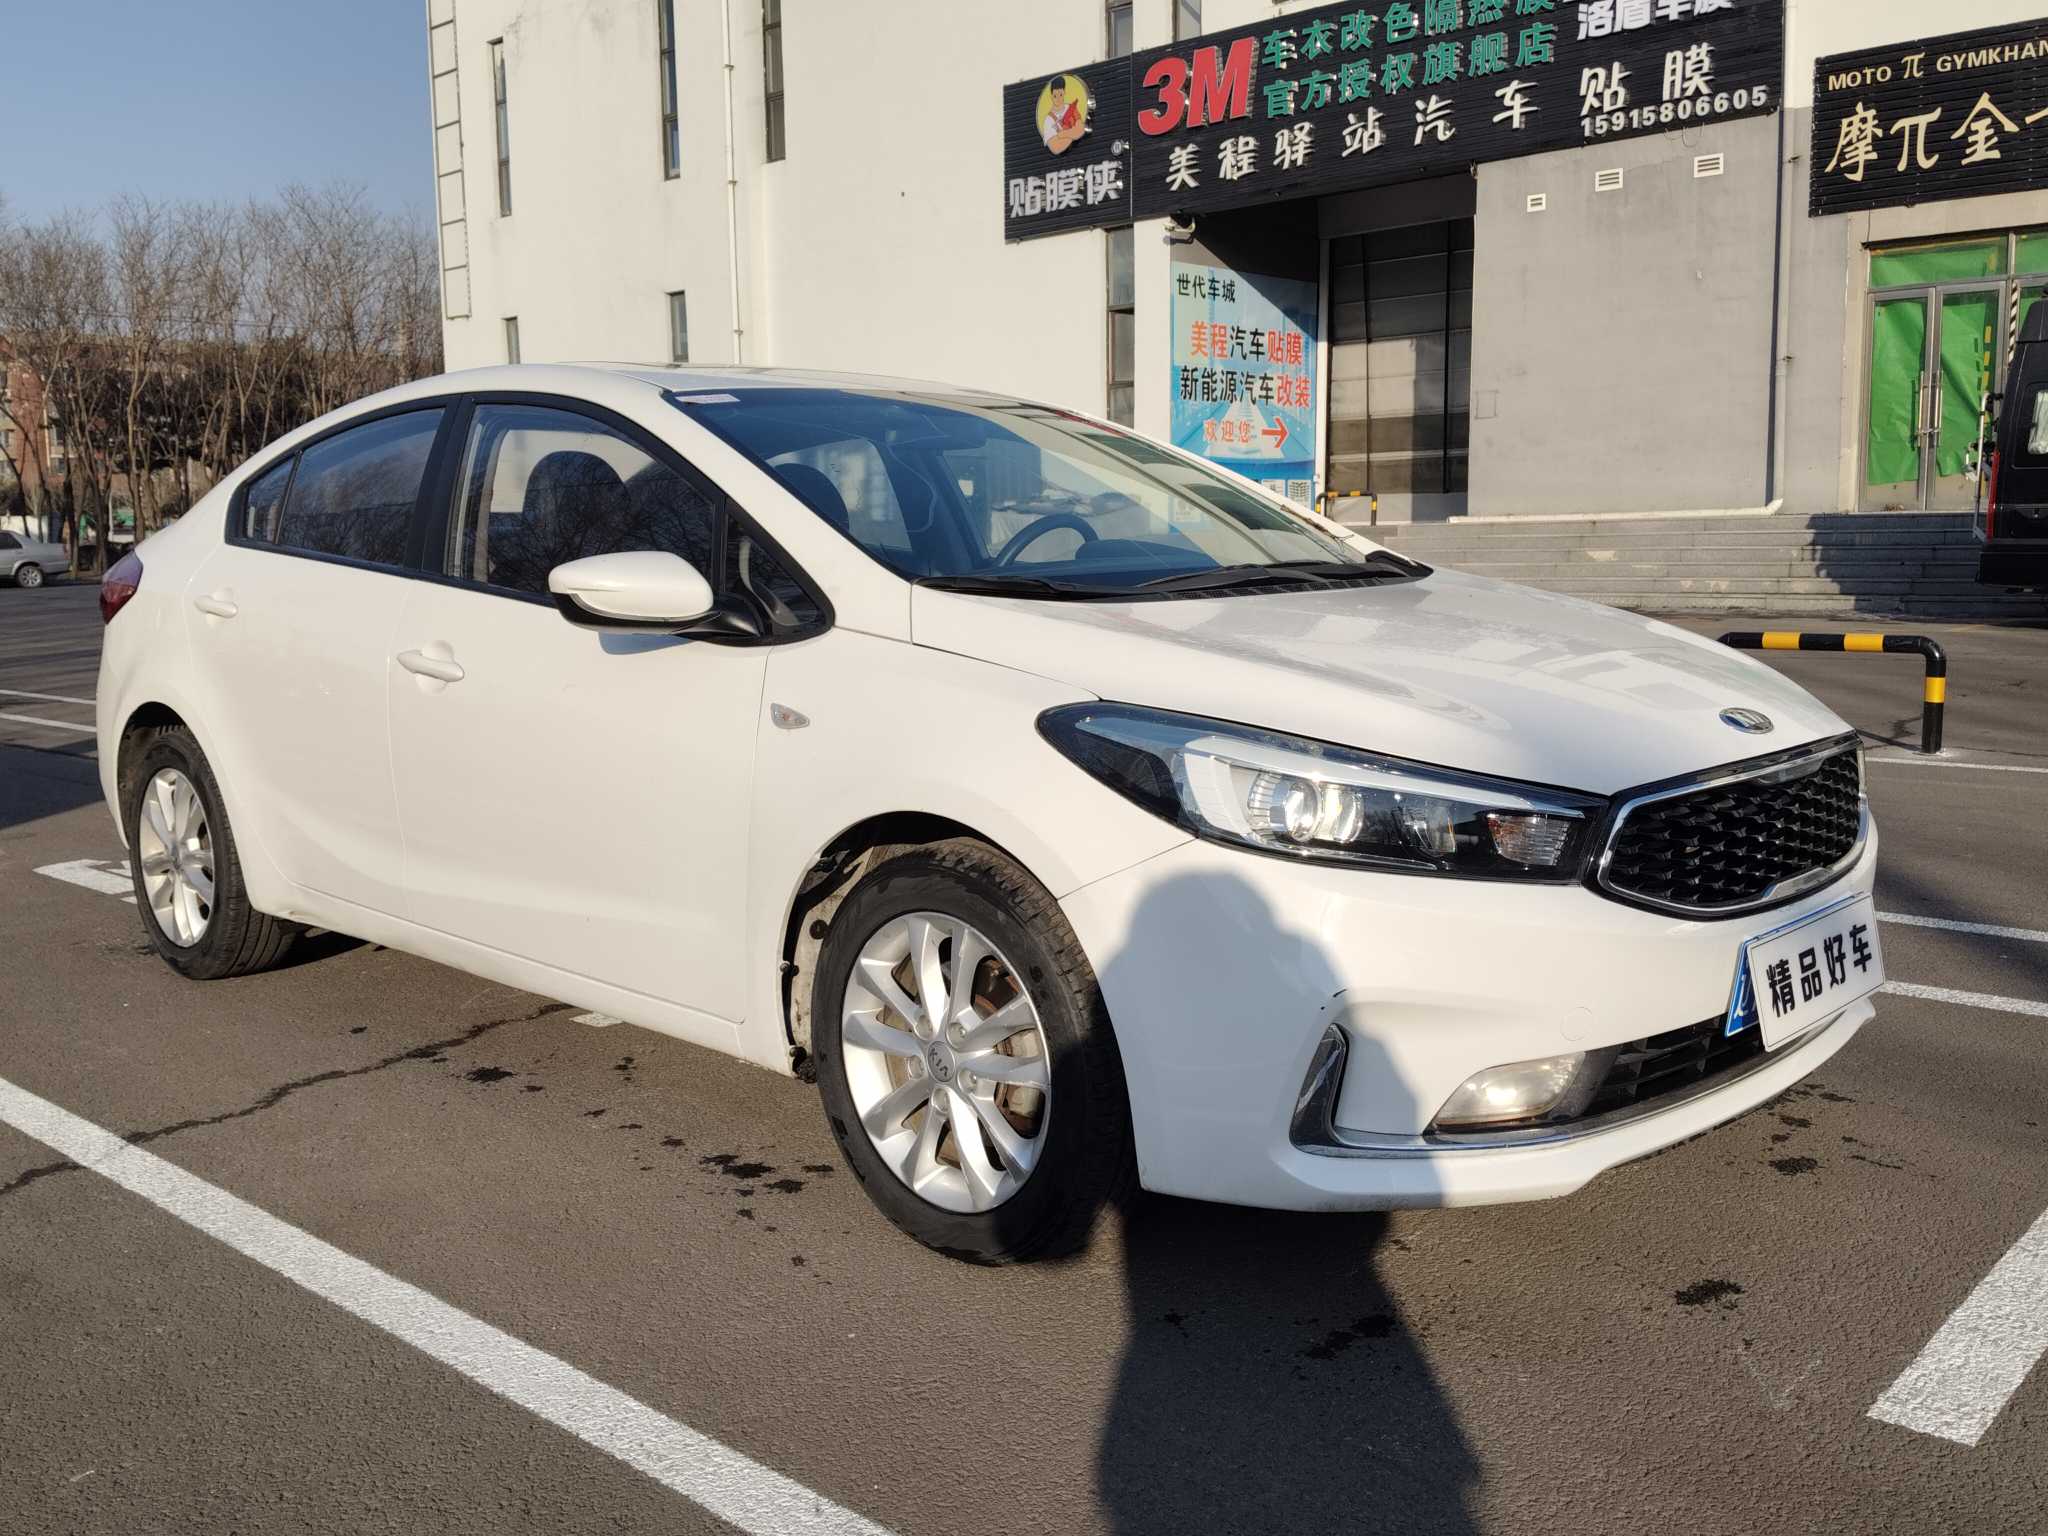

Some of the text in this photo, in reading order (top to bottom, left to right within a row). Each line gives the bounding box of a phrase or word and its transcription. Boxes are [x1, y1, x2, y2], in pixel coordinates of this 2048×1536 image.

[1138, 36, 1257, 136] 3M
[1263, 22, 1558, 118] 官方授权旗舰店
[1828, 66, 1892, 91] MOTO
[1165, 42, 1717, 192] 美程驿站汽车贴膜
[1581, 85, 1769, 137] 15915806605
[1008, 159, 1122, 218] 贴膜侠
[1176, 272, 1236, 304] 世代车城
[1190, 320, 1303, 365] 美程汽车贴膜
[1180, 365, 1311, 408] 新能源汽车改装
[1766, 924, 1873, 1018] 精品好车
